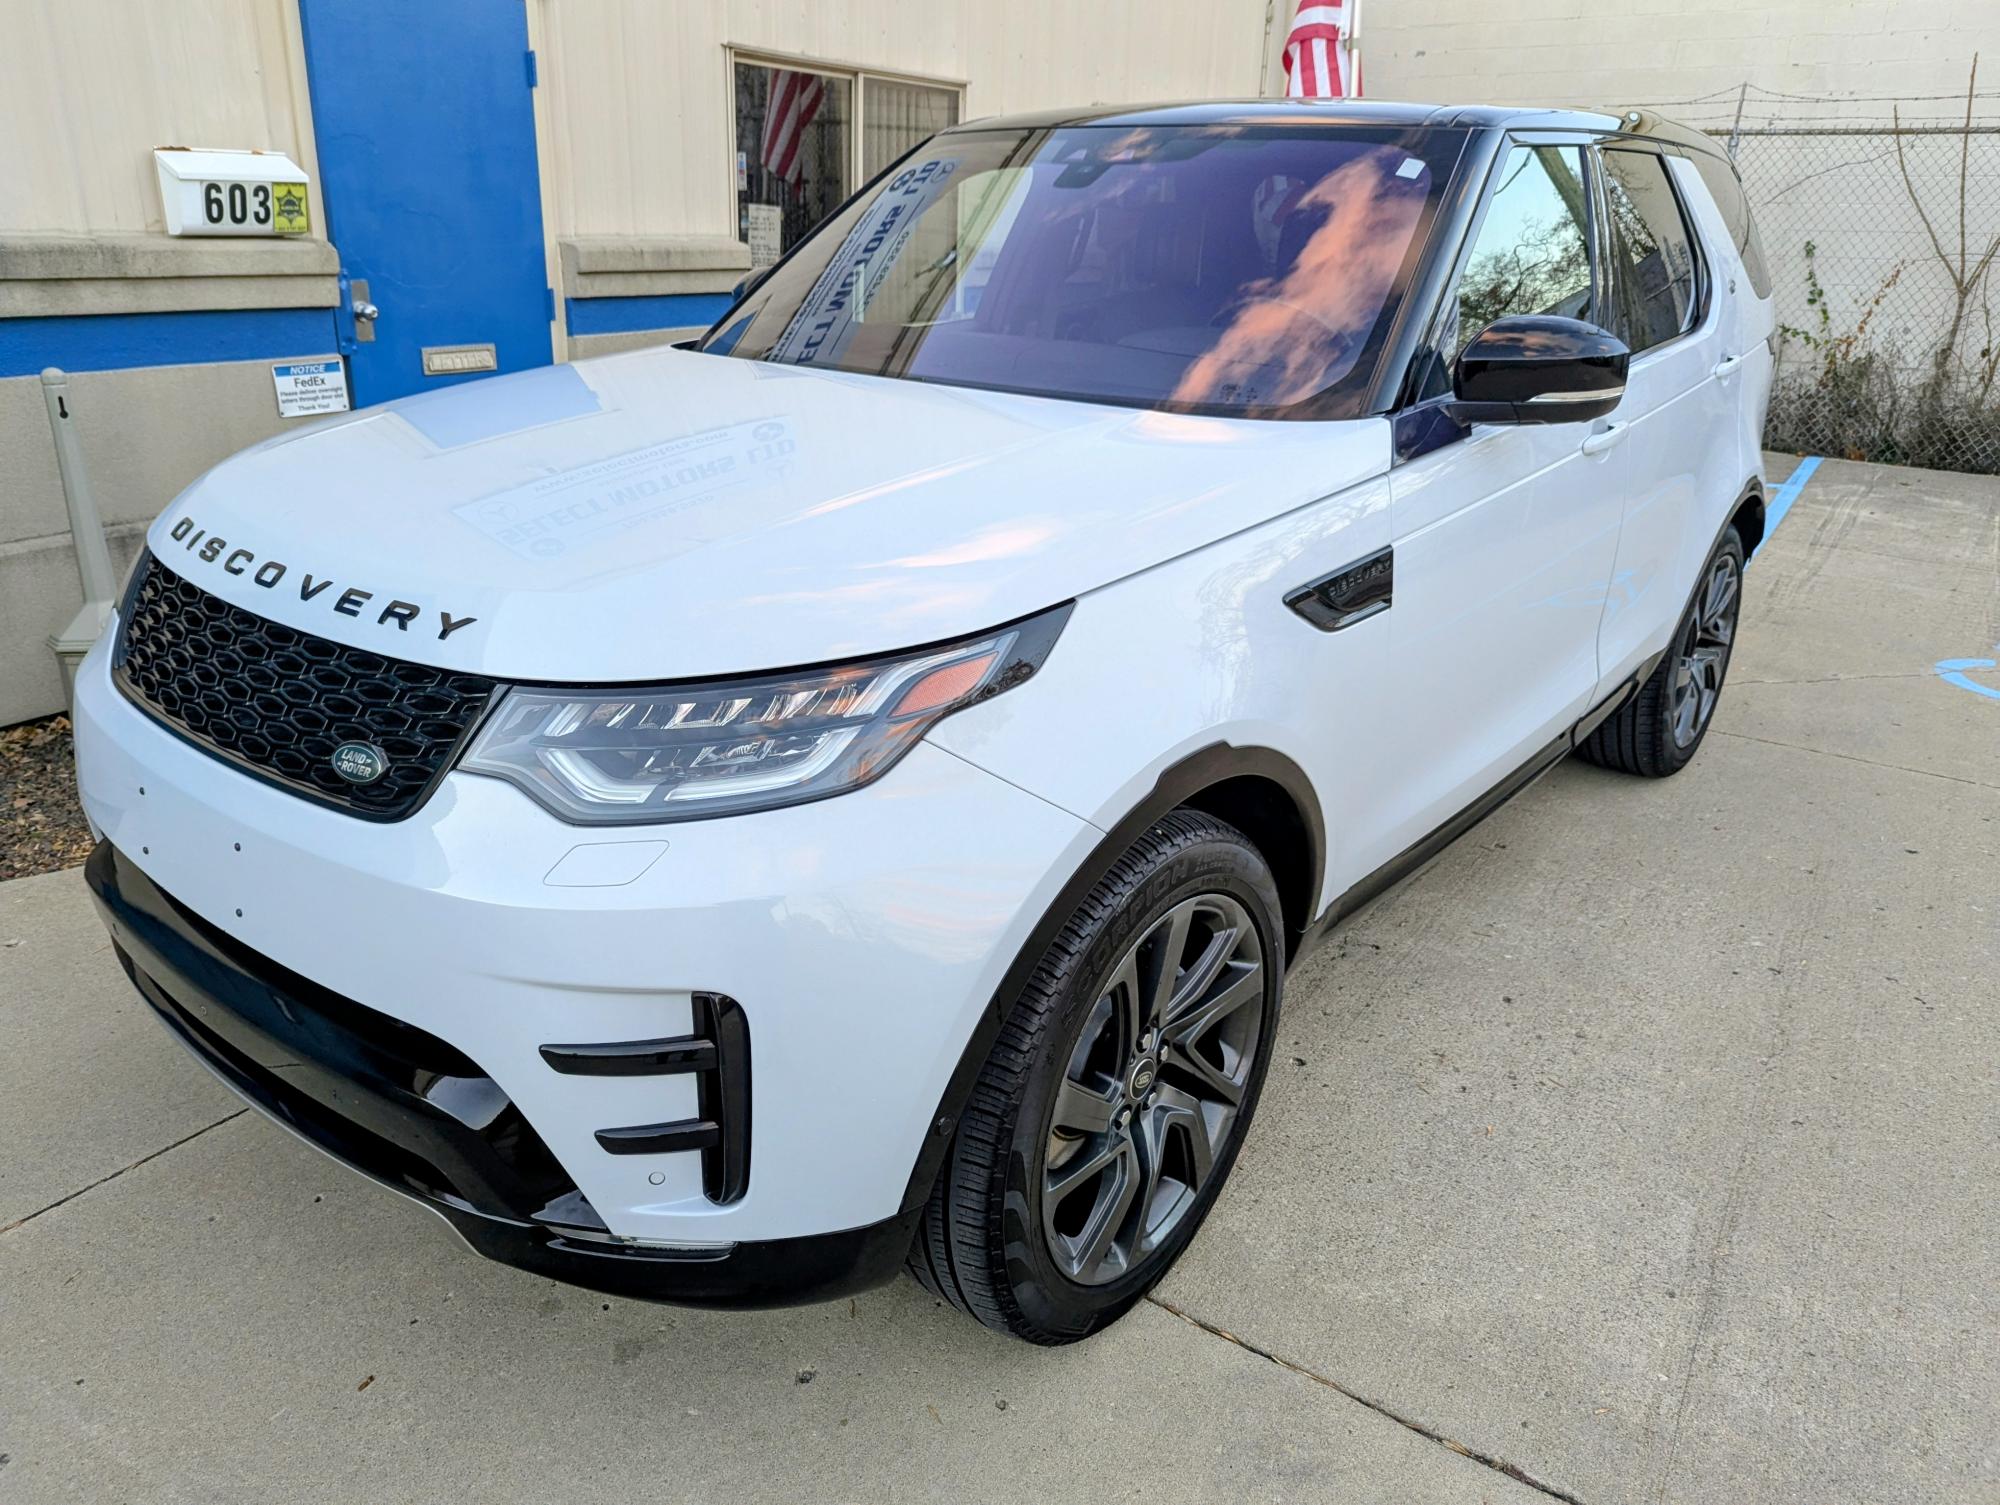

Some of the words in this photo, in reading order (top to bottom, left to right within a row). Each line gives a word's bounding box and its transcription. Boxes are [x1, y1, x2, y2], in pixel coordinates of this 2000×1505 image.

[204, 183, 271, 225] 603
[290, 364, 326, 375] NOTICE
[294, 376, 327, 388] FedEx
[170, 516, 478, 641] DISCOVERY
[341, 749, 367, 764] LAND
[340, 761, 372, 778] ROVER
